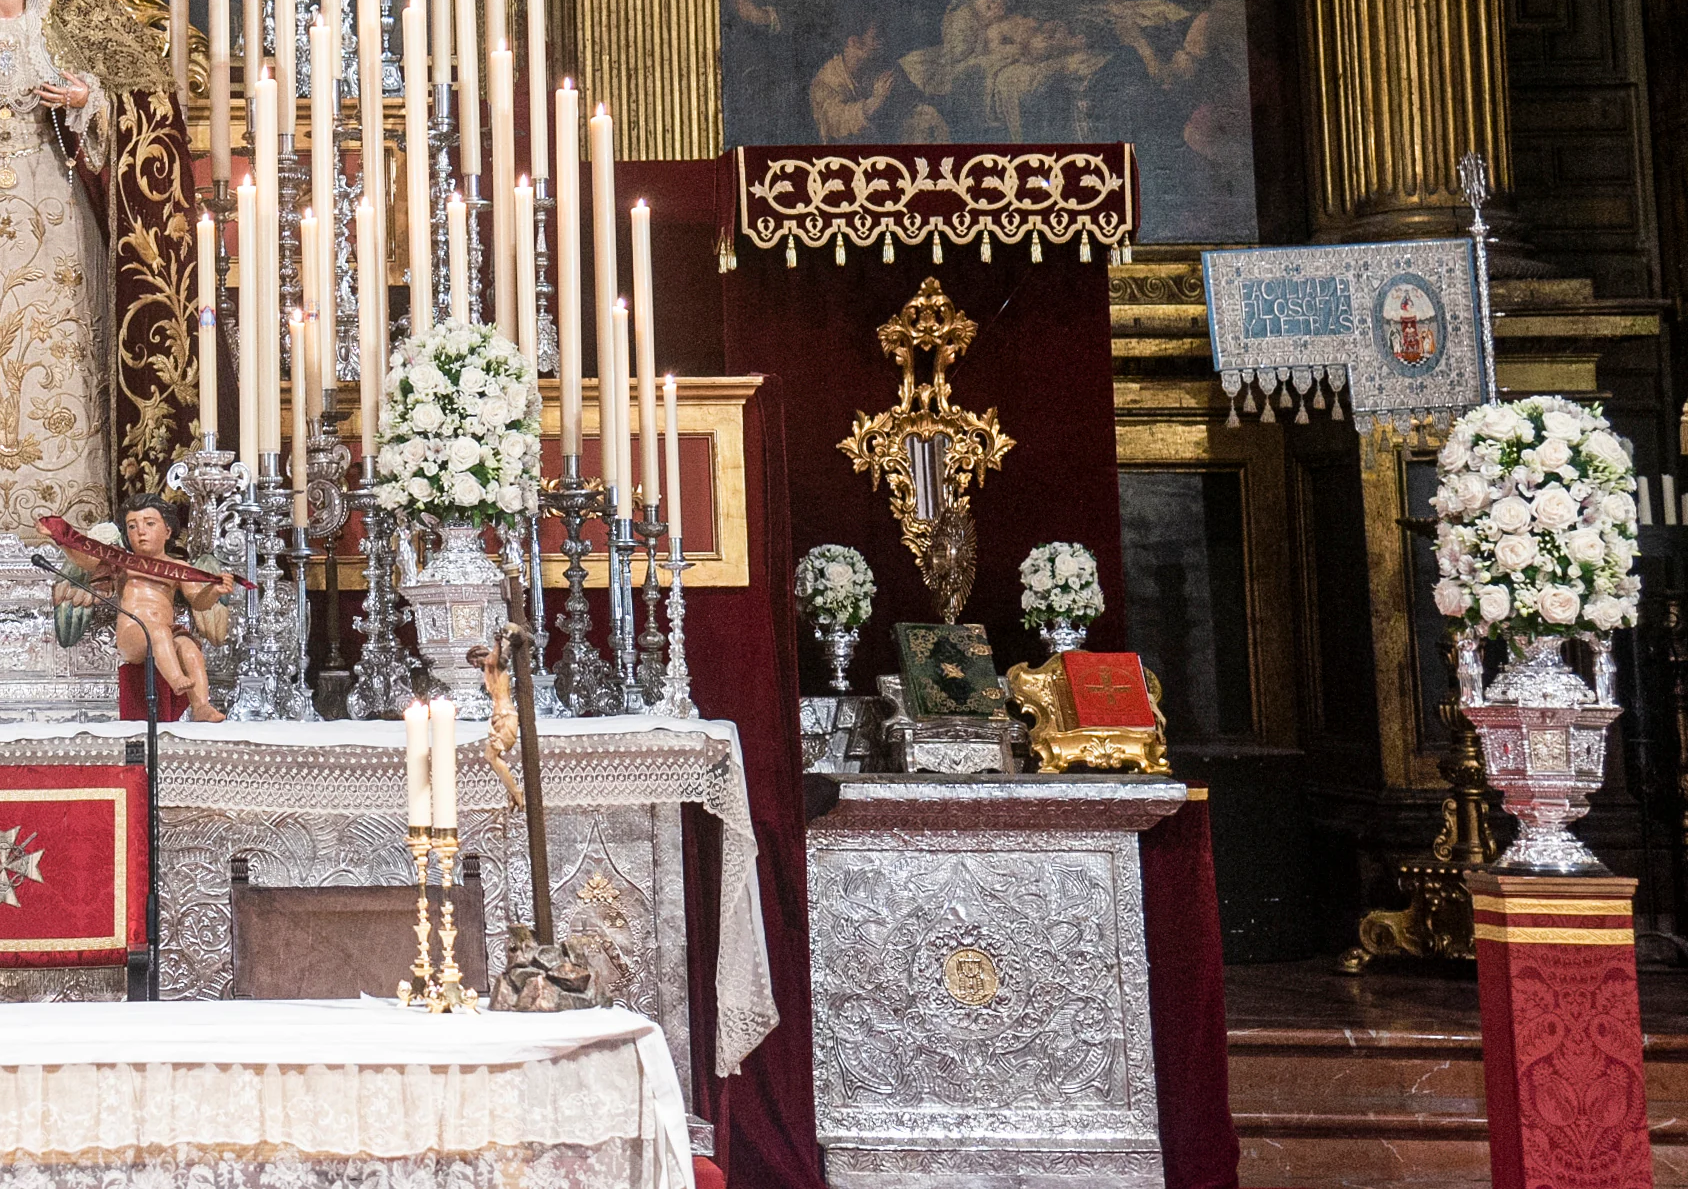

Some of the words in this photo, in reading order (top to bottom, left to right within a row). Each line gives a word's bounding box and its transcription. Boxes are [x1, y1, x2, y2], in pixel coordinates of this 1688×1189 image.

[1241, 297, 1351, 319] FILOSOFIA
[1242, 318, 1256, 338] Y
[1266, 314, 1354, 337] LETRAS
[82, 540, 189, 580] SAPIENTIAE
